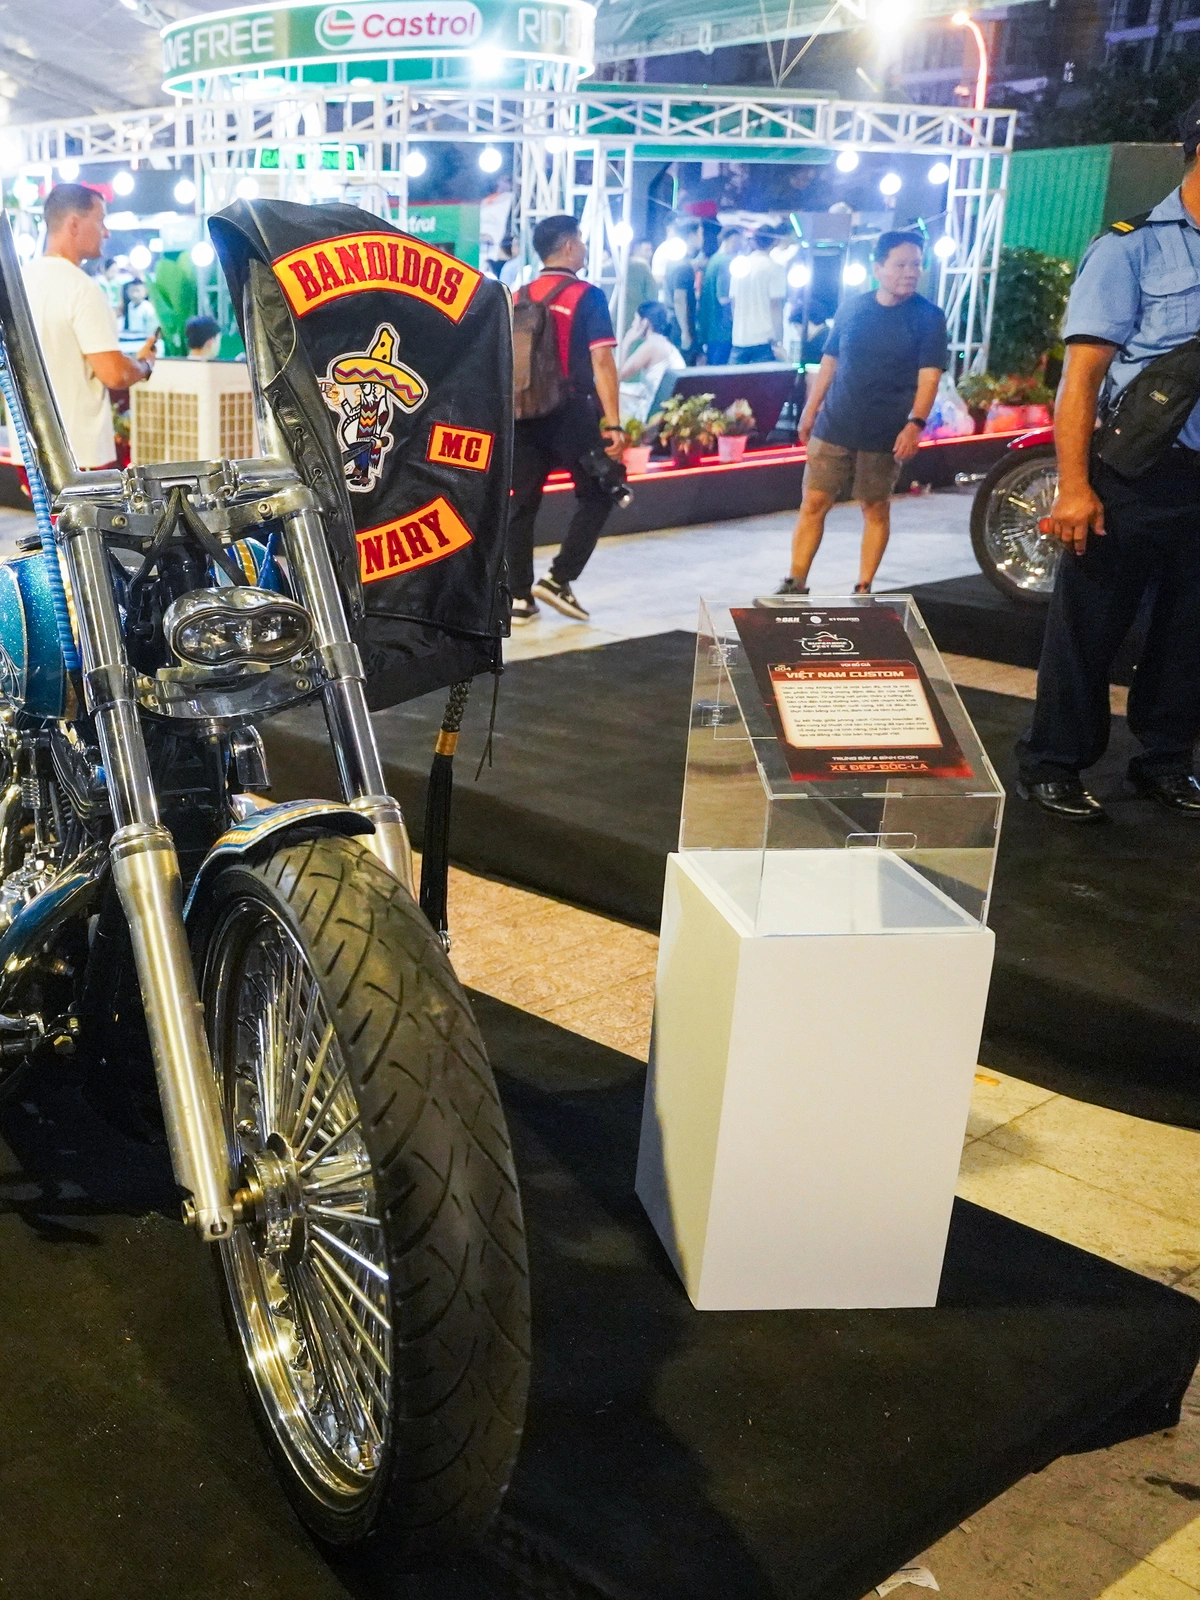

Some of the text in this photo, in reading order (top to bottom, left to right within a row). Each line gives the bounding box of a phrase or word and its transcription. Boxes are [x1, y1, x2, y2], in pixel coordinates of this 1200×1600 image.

[194, 16, 275, 63] FREE
[362, 12, 476, 38] Castrol
[288, 242, 464, 305] BANDIDOS
[438, 431, 483, 462] MC
[356, 509, 451, 575] NARY
[786, 670, 814, 680] VIỆT
